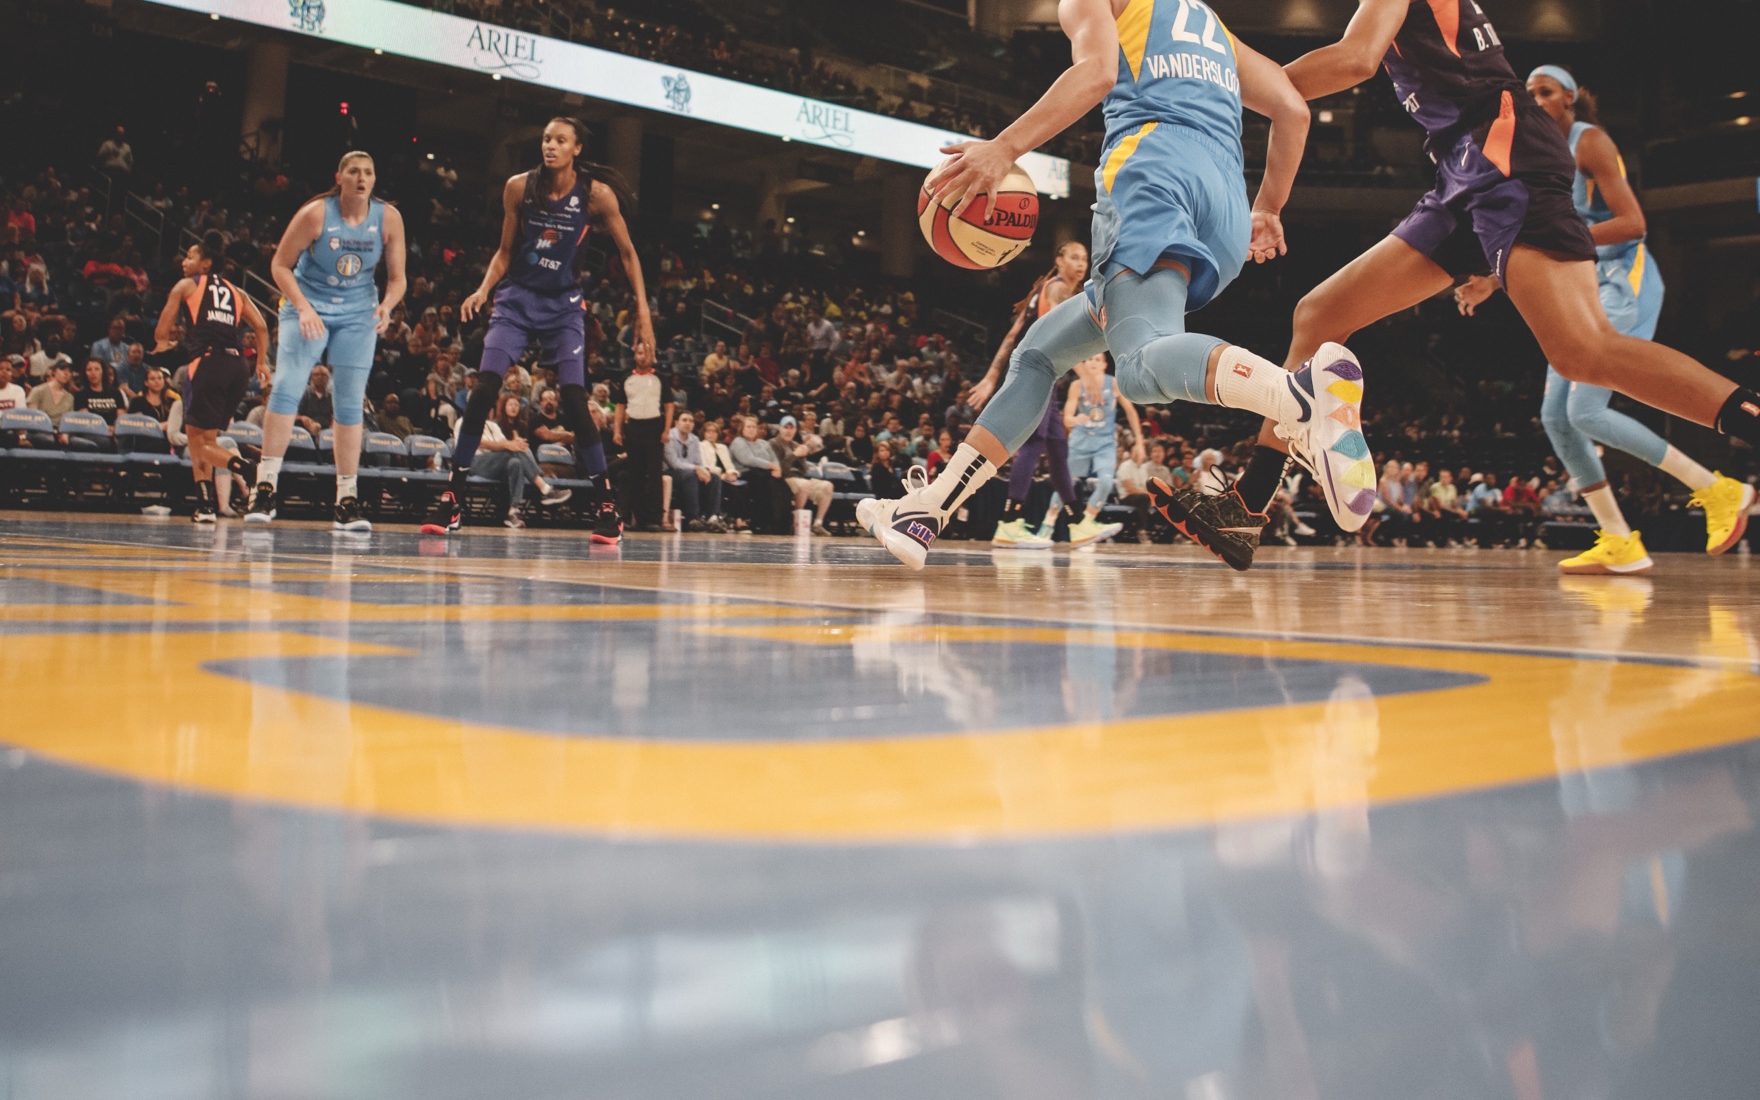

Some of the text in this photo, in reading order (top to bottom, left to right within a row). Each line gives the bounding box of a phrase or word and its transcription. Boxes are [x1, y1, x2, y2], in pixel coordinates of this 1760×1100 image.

[466, 24, 543, 68] ARIEL
[796, 100, 856, 138] ARIEL
[538, 256, 562, 271] AT&T
[208, 284, 232, 311] 12
